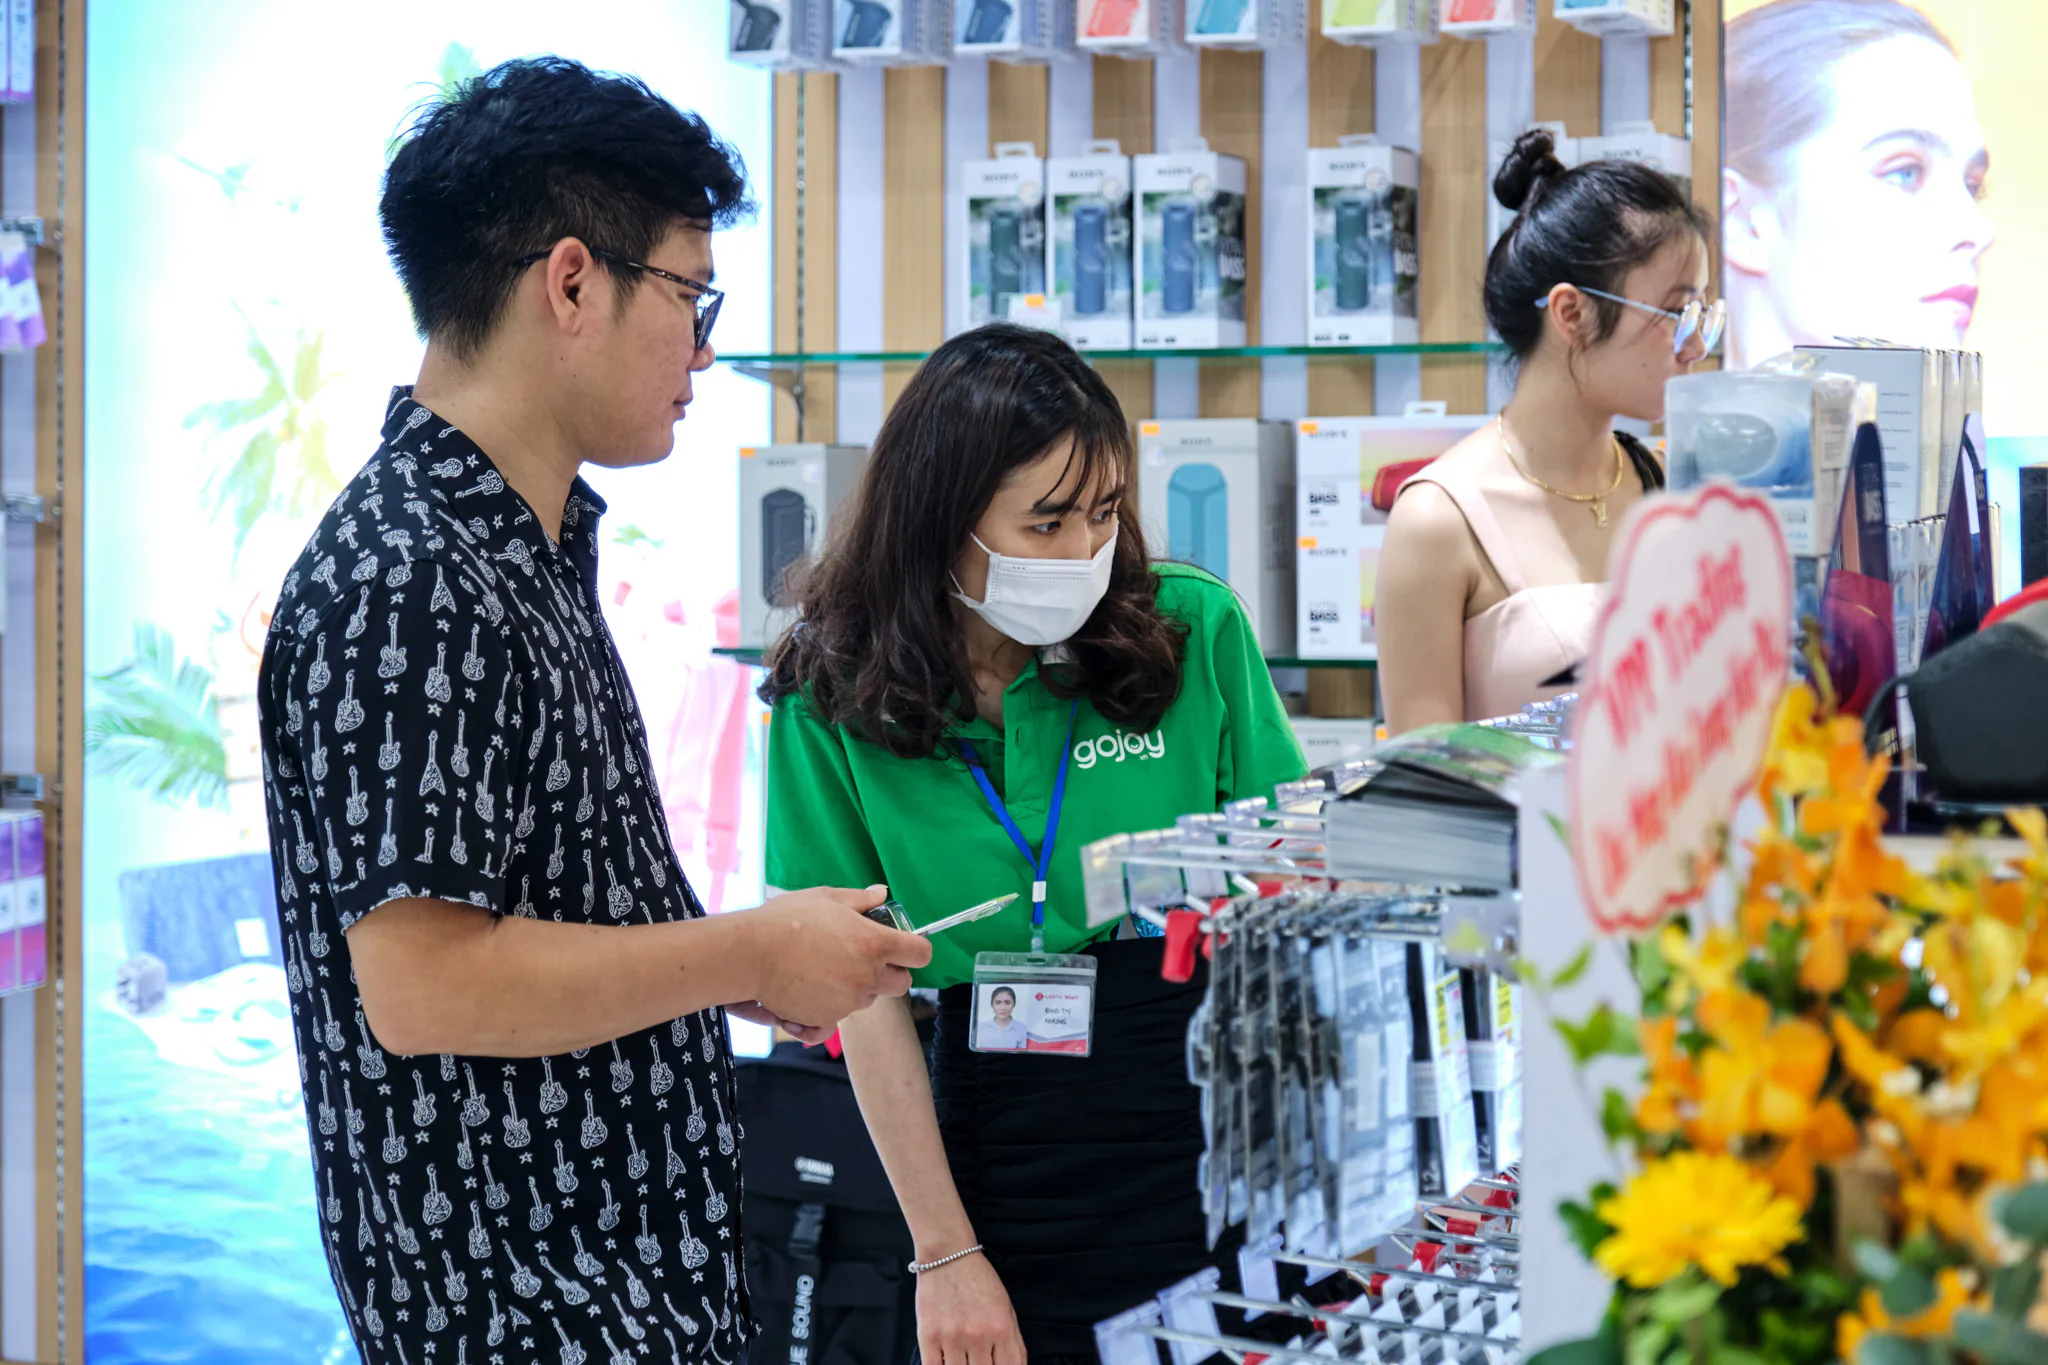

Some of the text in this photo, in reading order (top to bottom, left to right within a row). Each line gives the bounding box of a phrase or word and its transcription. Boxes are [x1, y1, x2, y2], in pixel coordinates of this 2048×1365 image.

[1157, 166, 1193, 177] SONY
[1329, 161, 1366, 171] SONY
[983, 172, 1020, 183] SONY
[1068, 169, 1105, 180] SONY
[1180, 436, 1212, 446] SONY
[1309, 492, 1339, 504] BASS
[1309, 610, 1340, 622] BASS
[1073, 729, 1165, 769] gojoy
[791, 1274, 814, 1340] SOUND
